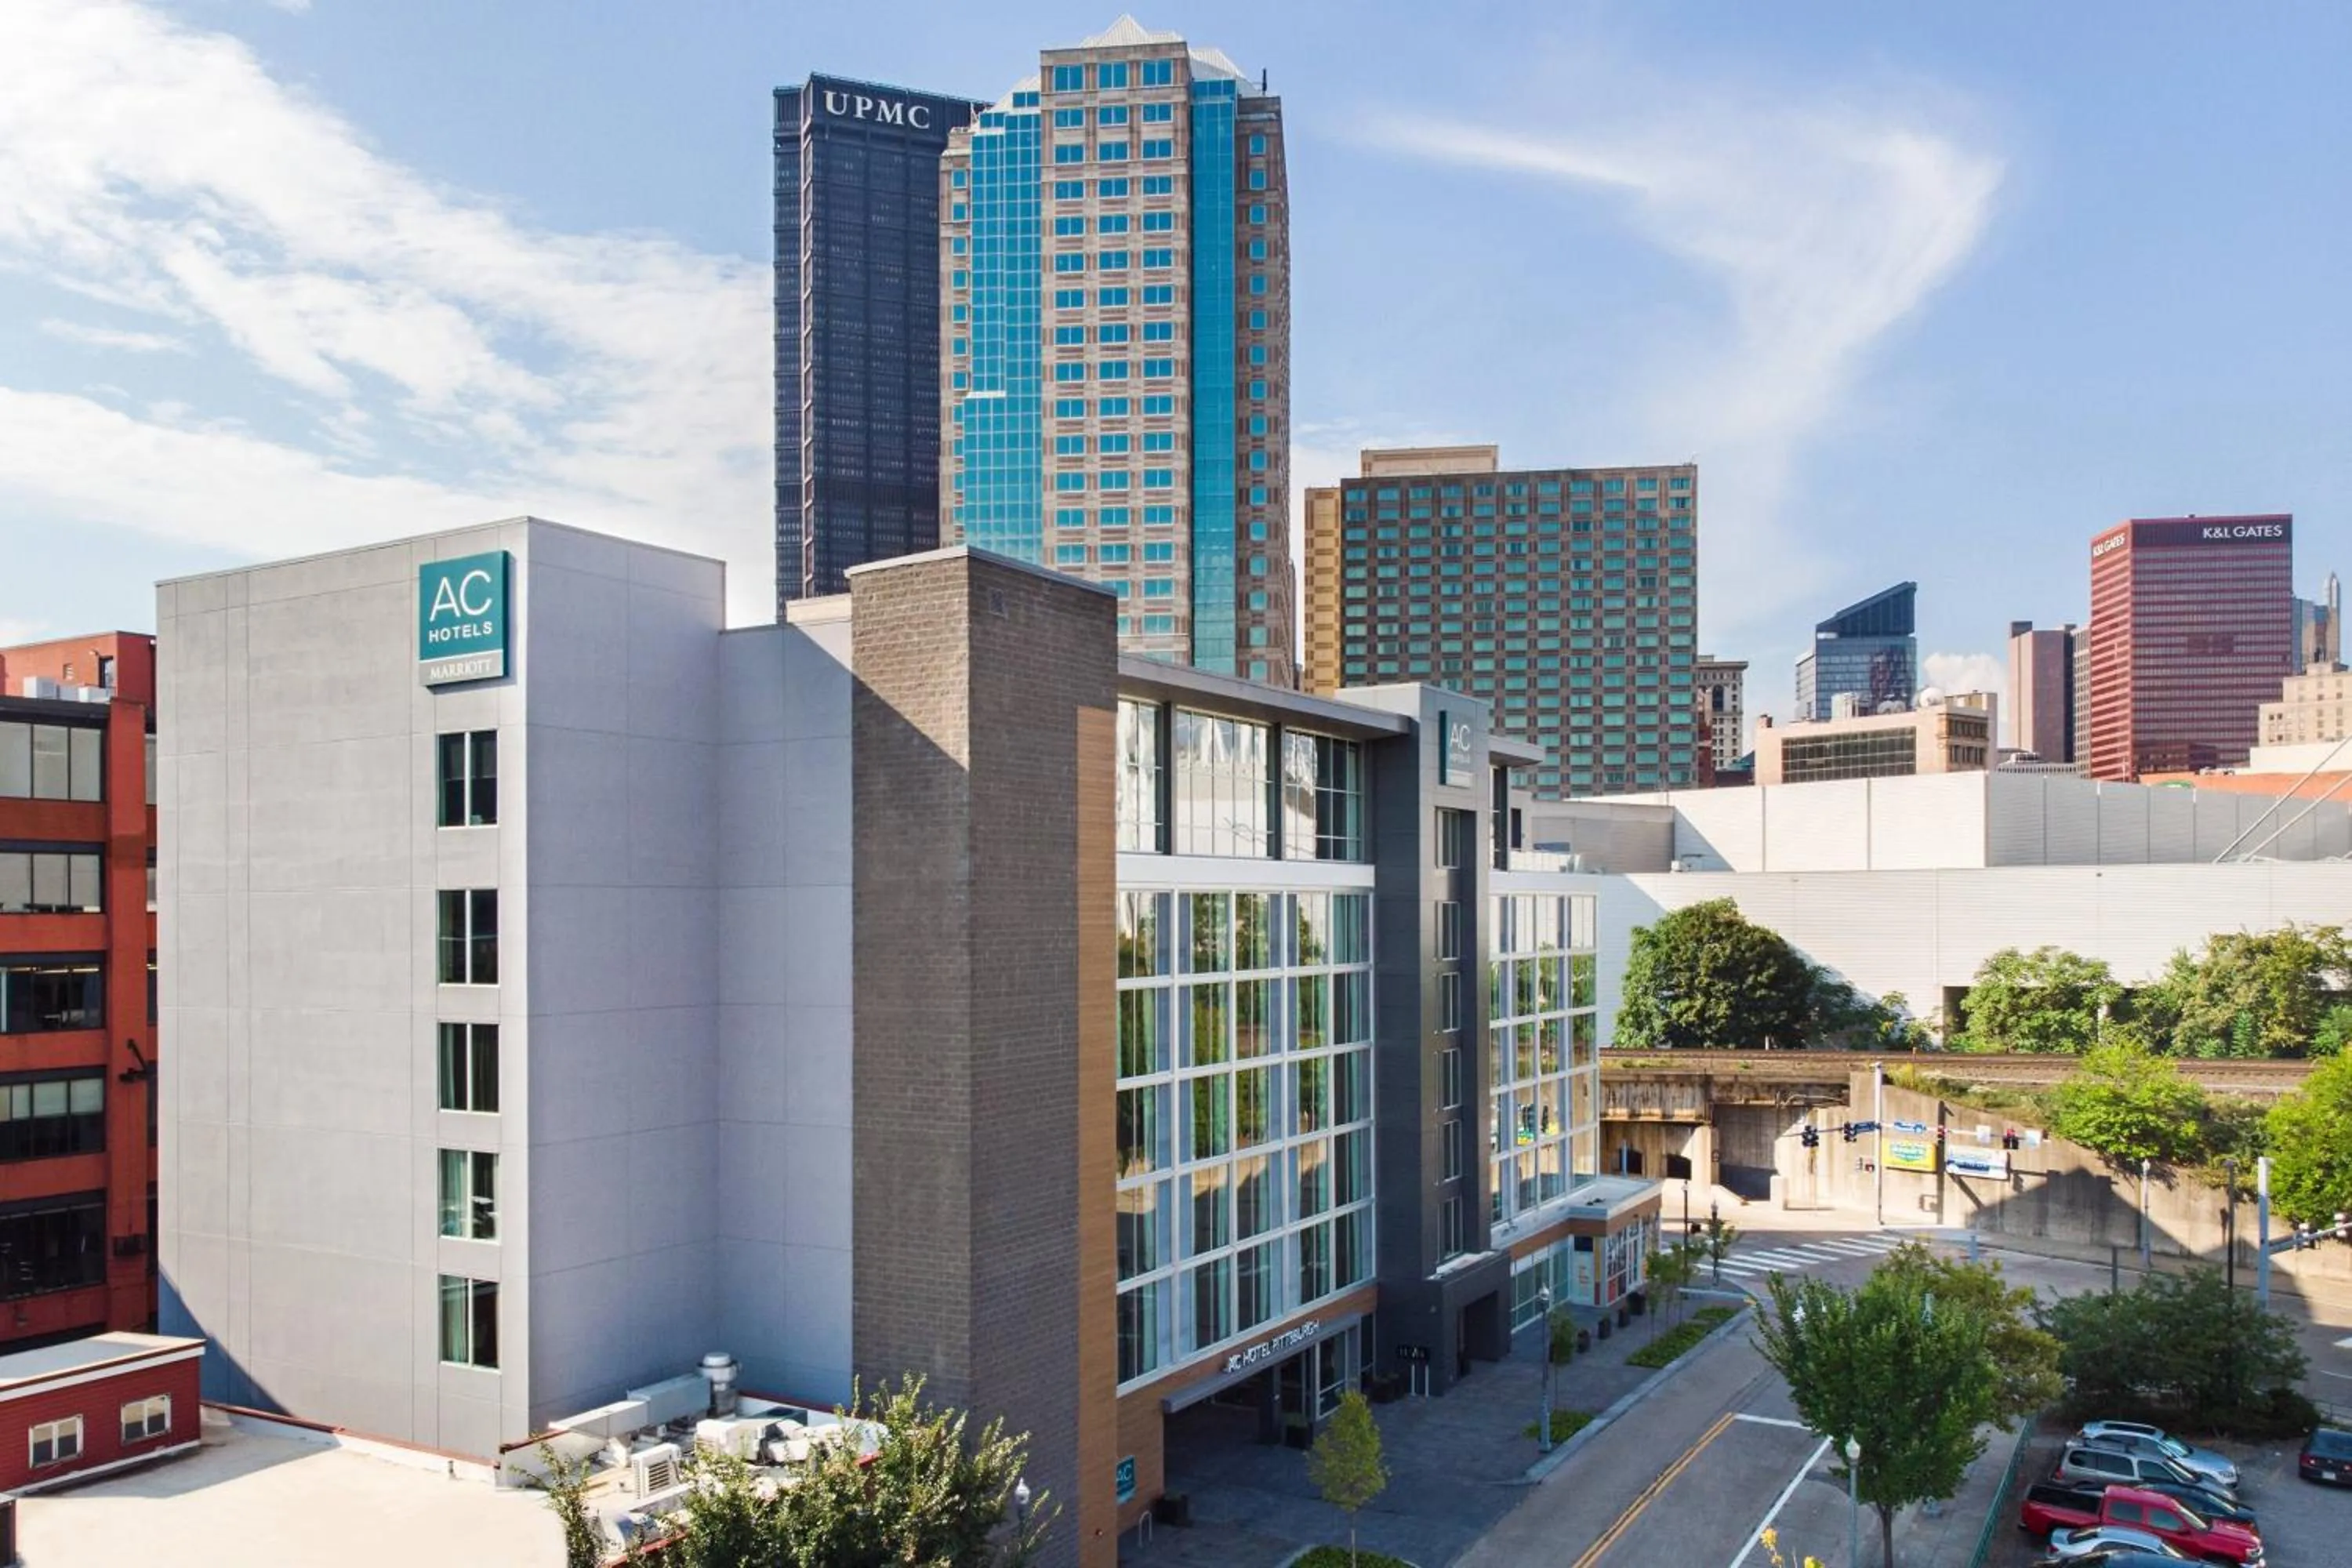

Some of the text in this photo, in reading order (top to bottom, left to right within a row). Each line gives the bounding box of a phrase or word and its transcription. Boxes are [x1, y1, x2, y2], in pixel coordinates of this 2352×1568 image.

[823, 89, 931, 129] UPMC
[2203, 524, 2283, 539] K&L GATES
[429, 569, 492, 622] AC
[429, 621, 493, 643] HOTELS
[430, 658, 492, 680] MARRIOTT
[1450, 722, 1471, 751] AC
[1229, 1319, 1319, 1373] AC HOTEL PITTSBURGH
